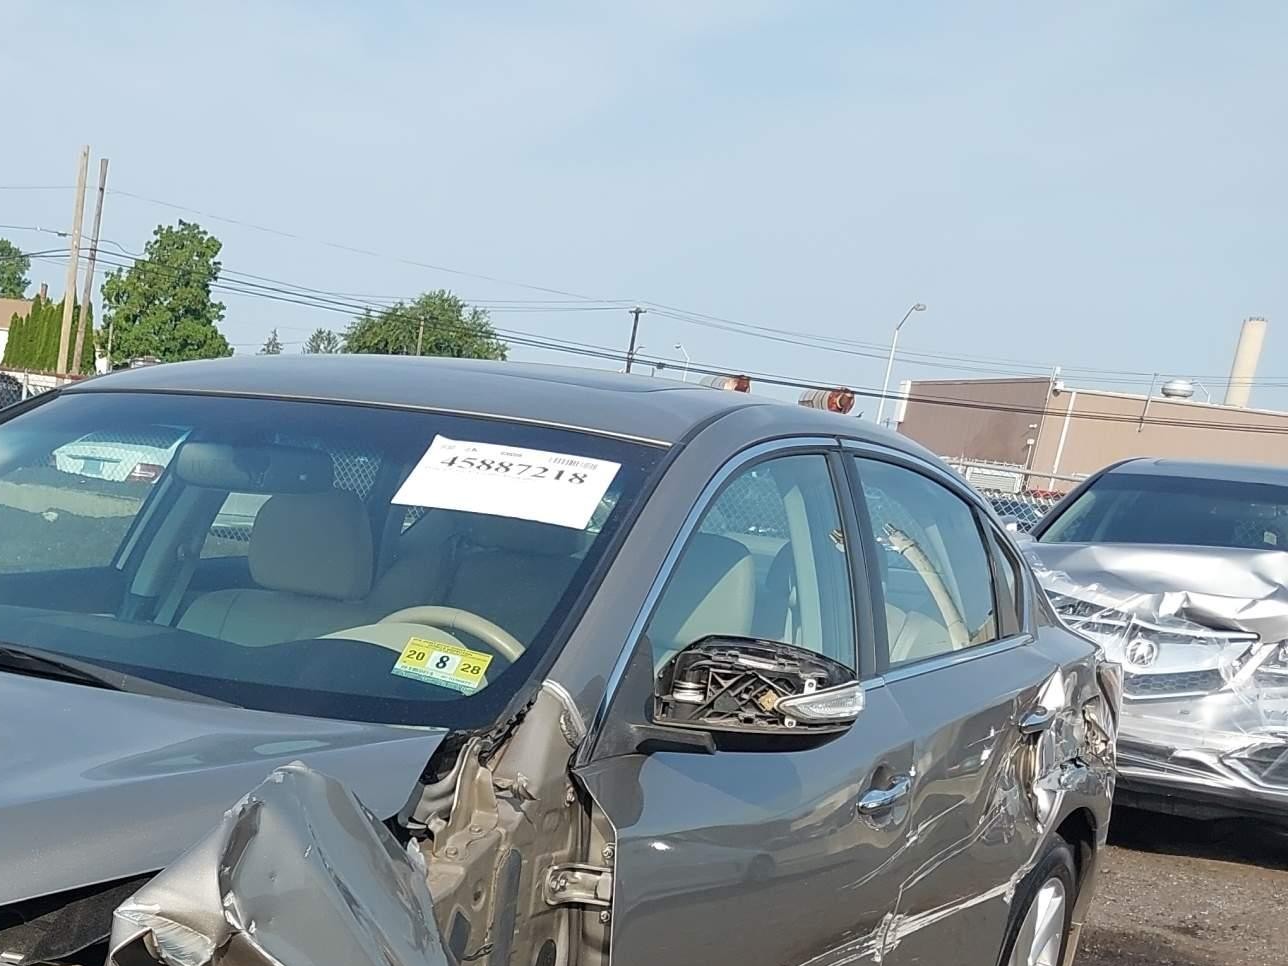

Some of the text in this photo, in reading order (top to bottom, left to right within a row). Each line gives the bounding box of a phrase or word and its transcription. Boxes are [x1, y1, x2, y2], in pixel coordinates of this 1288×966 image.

[440, 455, 588, 485] 45887218
[406, 649, 426, 662] 20
[435, 655, 450, 670] 8
[460, 663, 481, 676] 28
